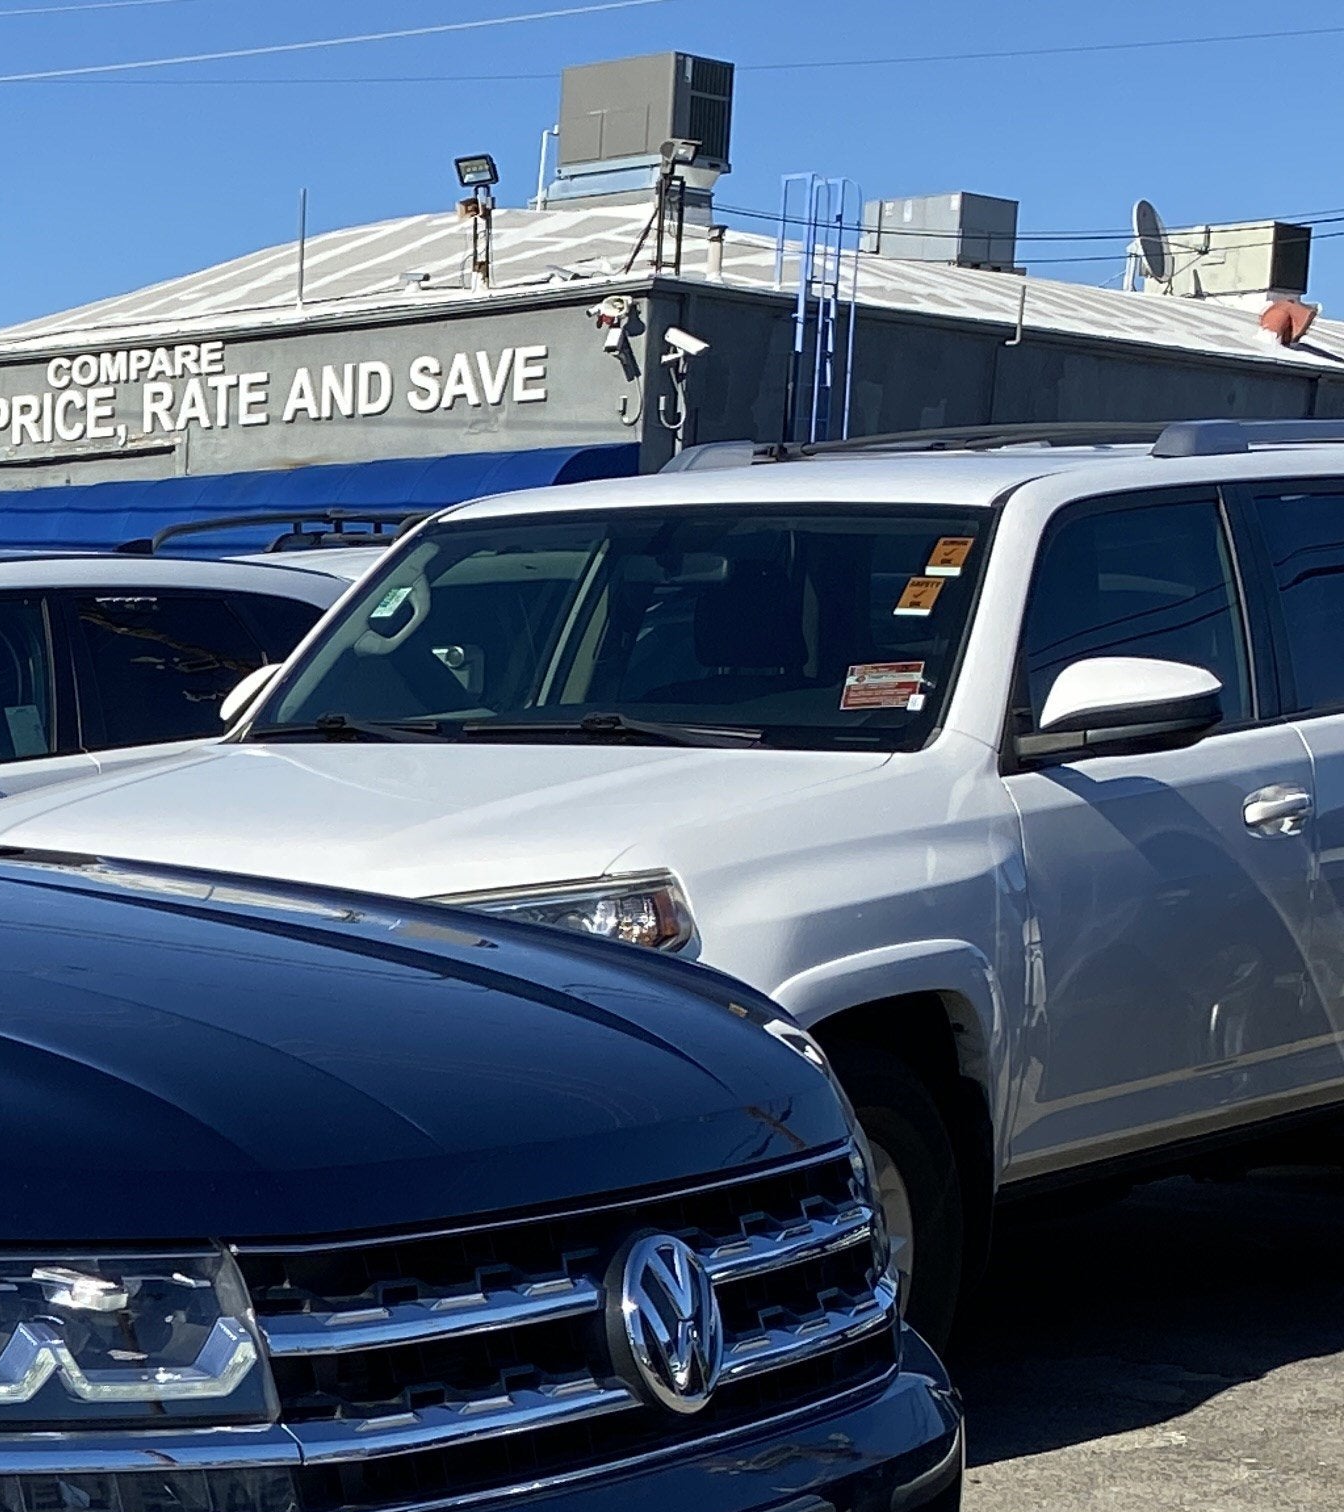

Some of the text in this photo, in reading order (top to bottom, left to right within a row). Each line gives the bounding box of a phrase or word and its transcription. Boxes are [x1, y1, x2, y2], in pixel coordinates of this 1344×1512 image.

[47, 341, 224, 389] COMPARE
[143, 371, 270, 434] RATE
[282, 360, 393, 422] AND
[407, 345, 548, 412] SAVE
